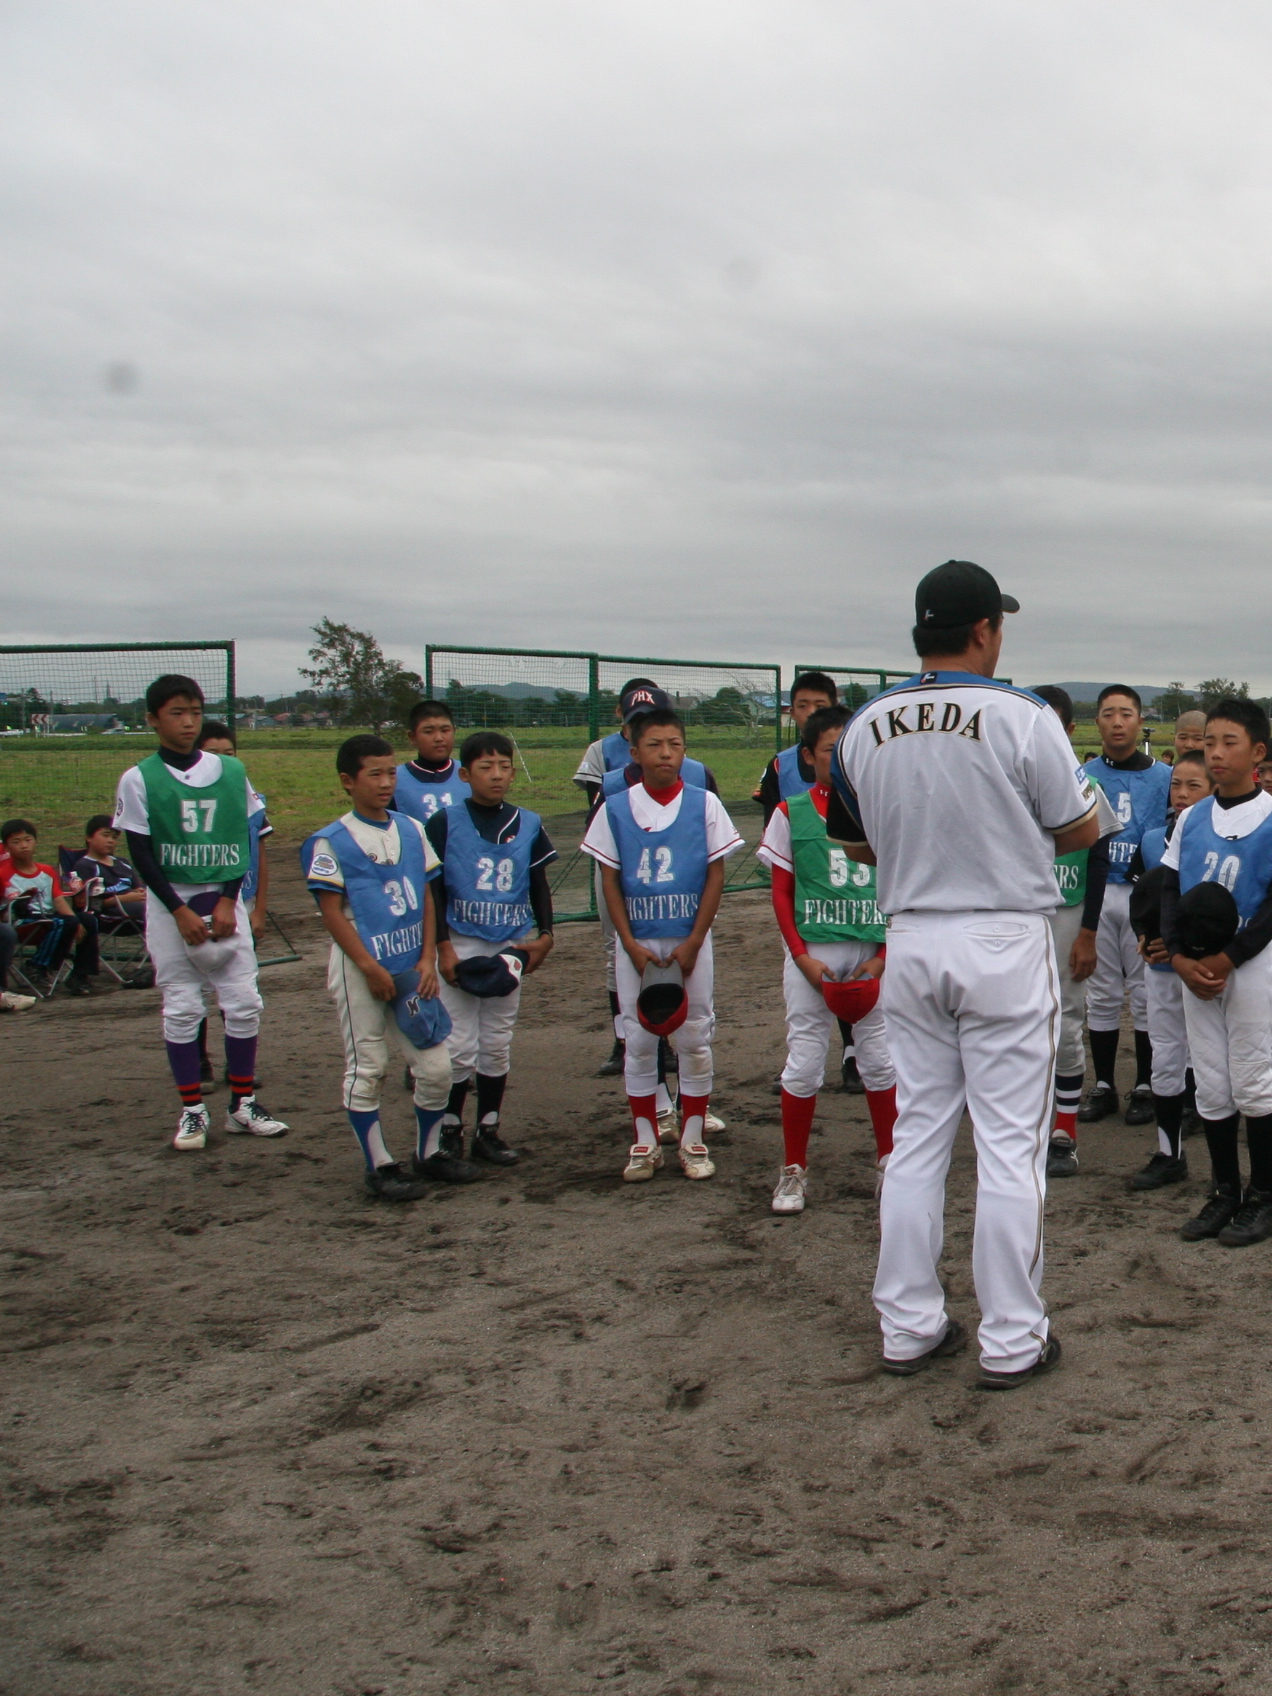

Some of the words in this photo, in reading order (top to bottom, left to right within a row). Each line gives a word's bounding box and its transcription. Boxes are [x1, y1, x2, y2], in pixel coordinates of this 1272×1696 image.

[630, 689, 656, 706] PHX
[868, 702, 983, 749] IKEDA
[181, 799, 218, 833] 57
[160, 843, 240, 868] FIGHTERS
[637, 846, 675, 884] 42
[1201, 851, 1240, 894] 20
[476, 857, 514, 892] 28
[453, 898, 531, 927] FIGHTERS
